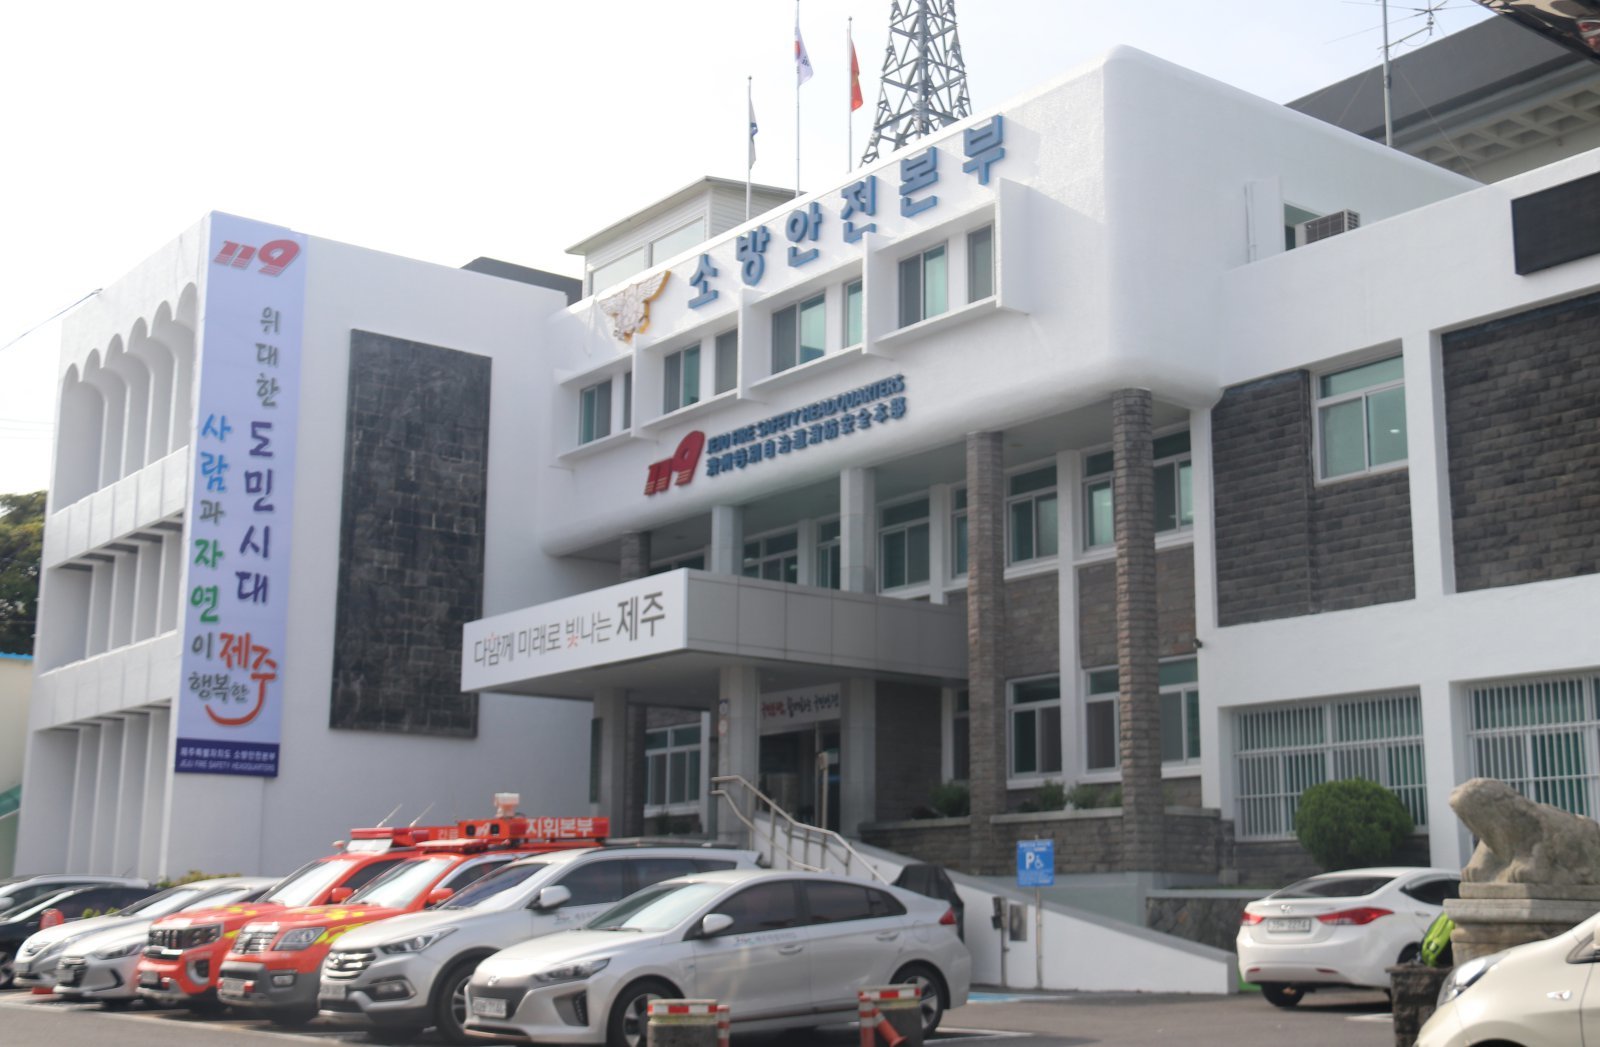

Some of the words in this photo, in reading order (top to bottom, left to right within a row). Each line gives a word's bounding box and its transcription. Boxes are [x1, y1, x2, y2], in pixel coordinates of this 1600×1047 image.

[687, 114, 1006, 309] 소방안전본부
[213, 239, 300, 277] 119
[256, 306, 280, 408] 위대한
[756, 409, 801, 438] SAFETY
[801, 373, 905, 423] HEADQUARTERS
[199, 413, 232, 526] 사람과
[644, 430, 705, 496] 119
[235, 420, 274, 604] 도민시대
[190, 538, 224, 660] 자연이
[474, 631, 514, 667] 다함께
[518, 622, 561, 658] 미래로
[565, 610, 612, 650] 빛나는
[617, 591, 665, 641] 제주
[188, 671, 249, 702] 행복한
[212, 631, 277, 708] 제주
